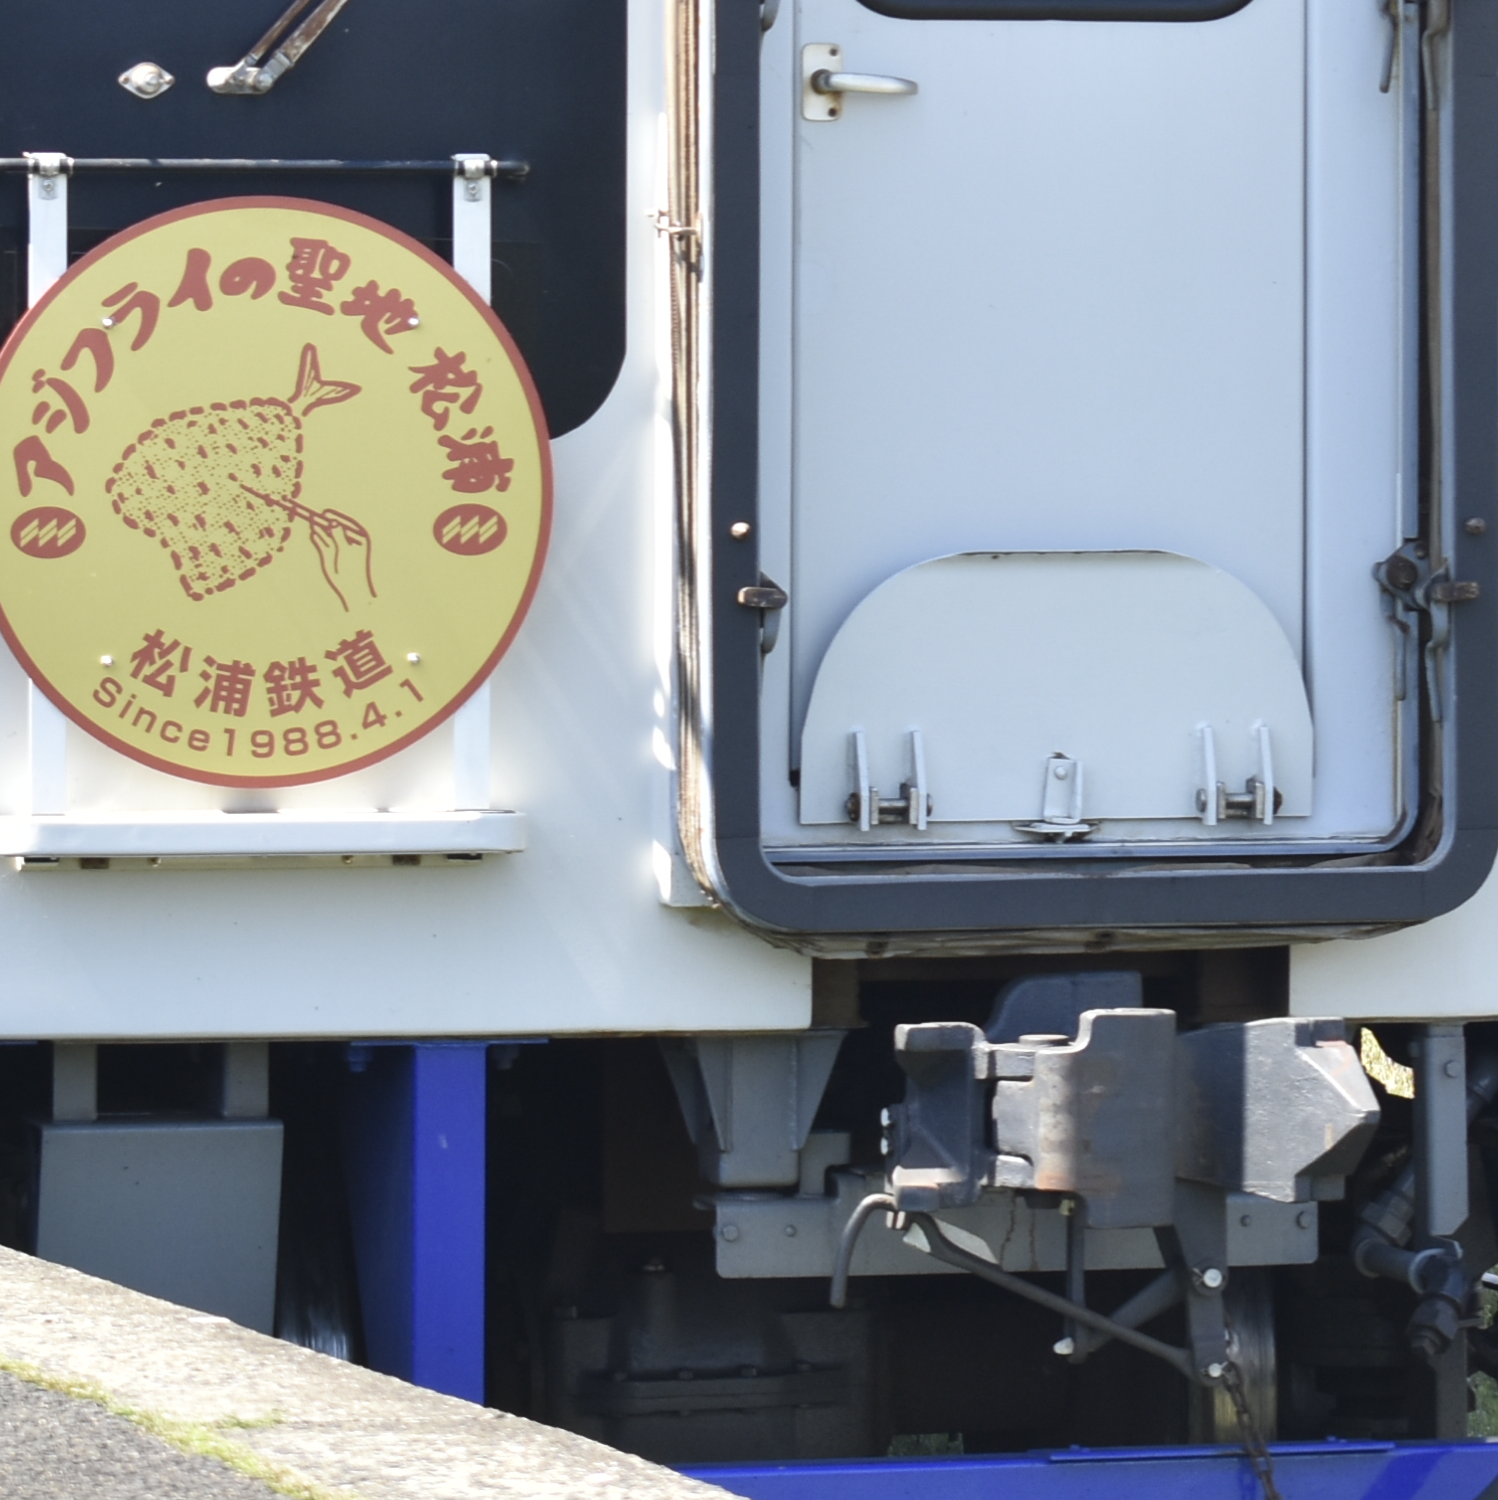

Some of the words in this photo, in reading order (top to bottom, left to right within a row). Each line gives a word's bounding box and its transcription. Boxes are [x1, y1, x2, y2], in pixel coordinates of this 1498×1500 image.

[13, 236, 419, 498] アジフライの聖地
[408, 346, 515, 494] 松浦
[129, 628, 394, 718] 松浦鉄道
